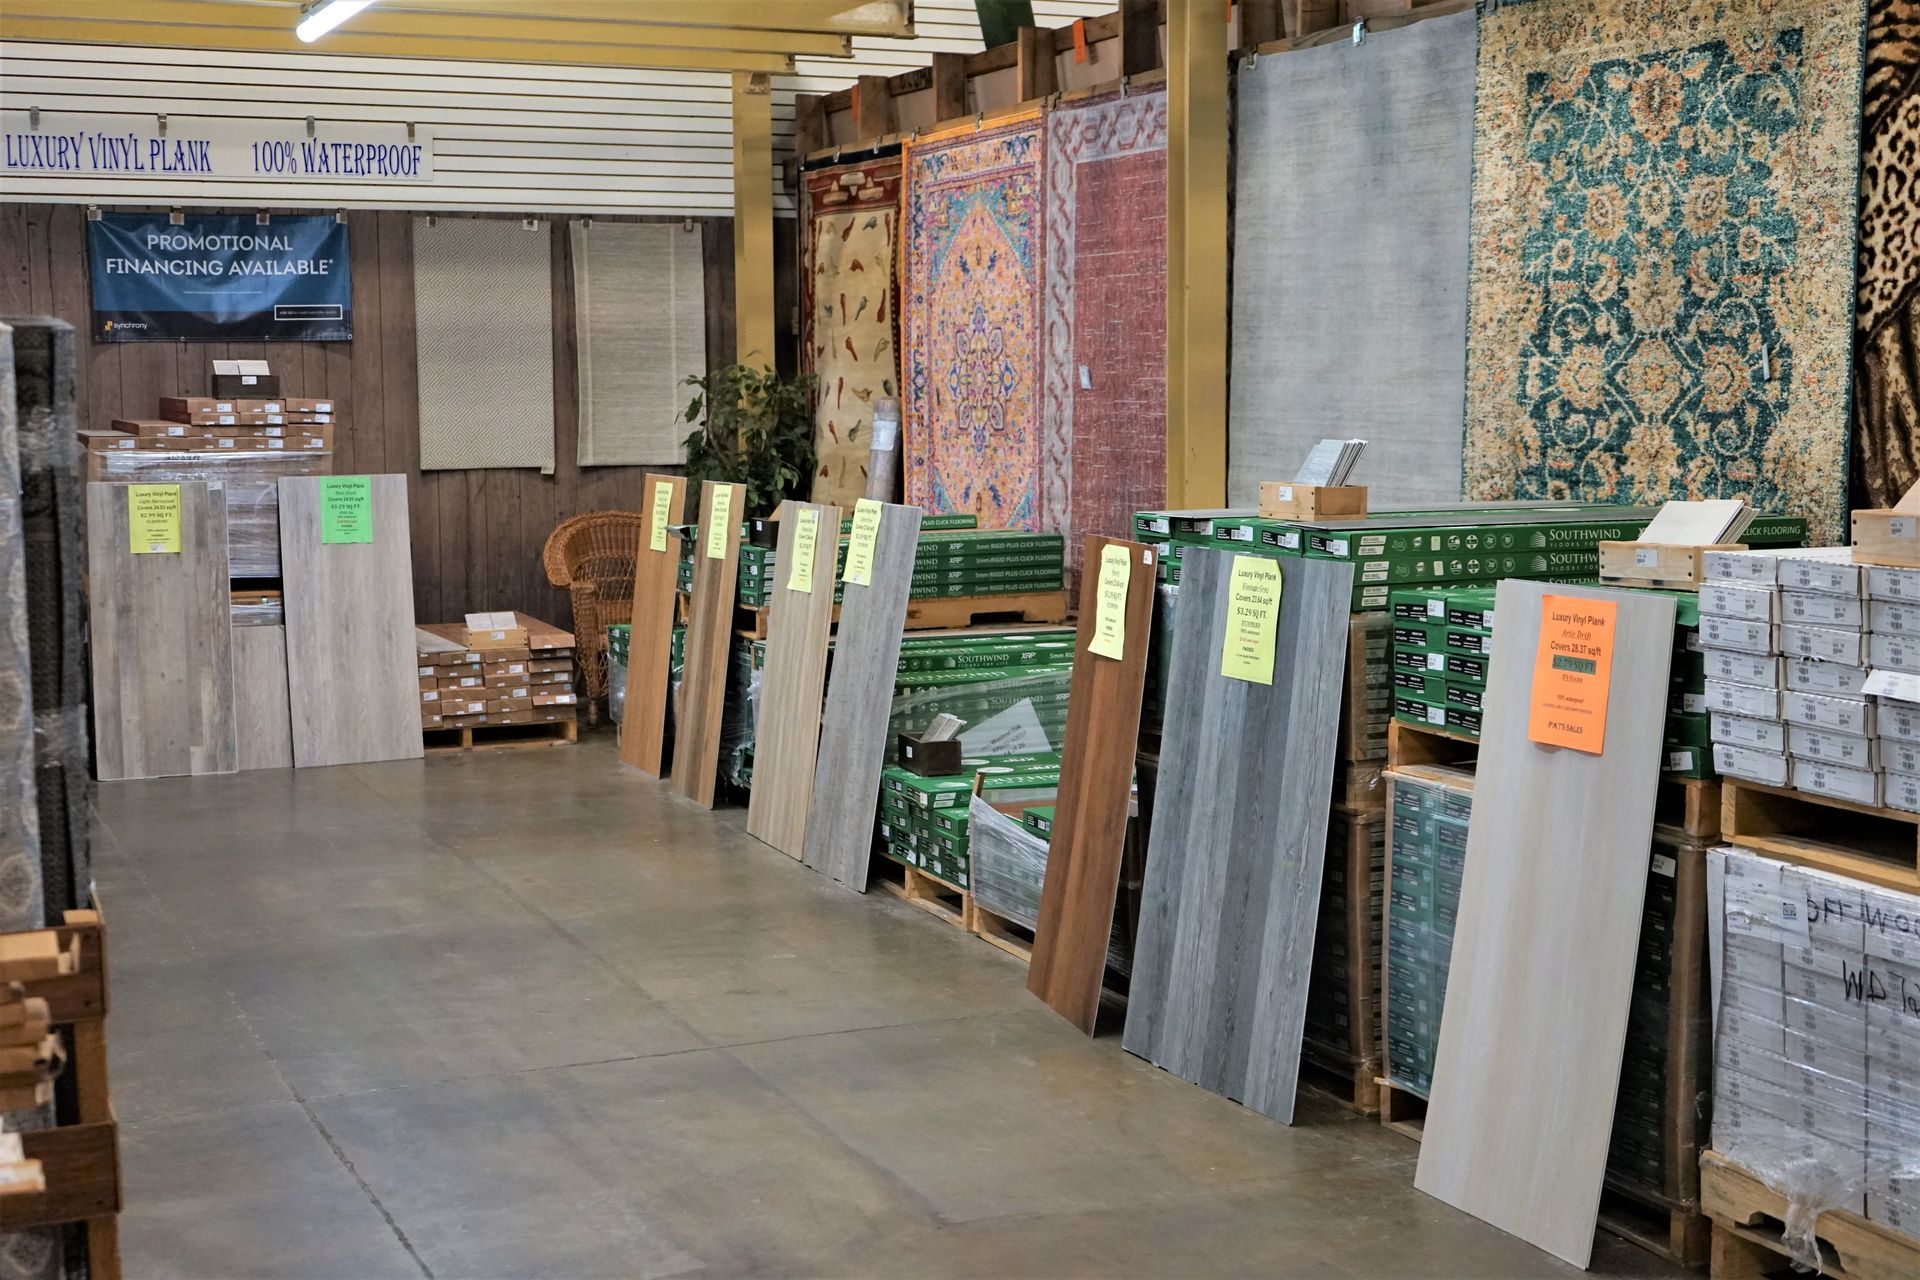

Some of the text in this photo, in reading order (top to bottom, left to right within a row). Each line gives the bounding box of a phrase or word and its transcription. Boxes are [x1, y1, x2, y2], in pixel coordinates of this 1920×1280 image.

[6, 131, 422, 176] LUXURY VINYL PLANK 100% WATERPROOF
[147, 234, 294, 251] PROMOTIONAL
[106, 258, 224, 276] FINANCING
[113, 322, 148, 331] synchrony
[949, 518, 976, 526] FLOORING
[1549, 528, 1621, 541] SOUTHWIND
[1763, 526, 1801, 536] FLOORING
[1238, 569, 1277, 581] Luxury Vinyl Plank
[1236, 593, 1251, 603] Covers
[1236, 607, 1252, 616] $3.29
[1252, 609, 1259, 620] SQ
[1552, 612, 1606, 627] Luxury Vinyl Plank
[1576, 630, 1592, 641] Drift
[1550, 640, 1571, 652] Covers
[1571, 643, 1587, 654] 28.37
[958, 653, 1009, 663] SOUTHWIND
[1566, 724, 1584, 734] SALES
